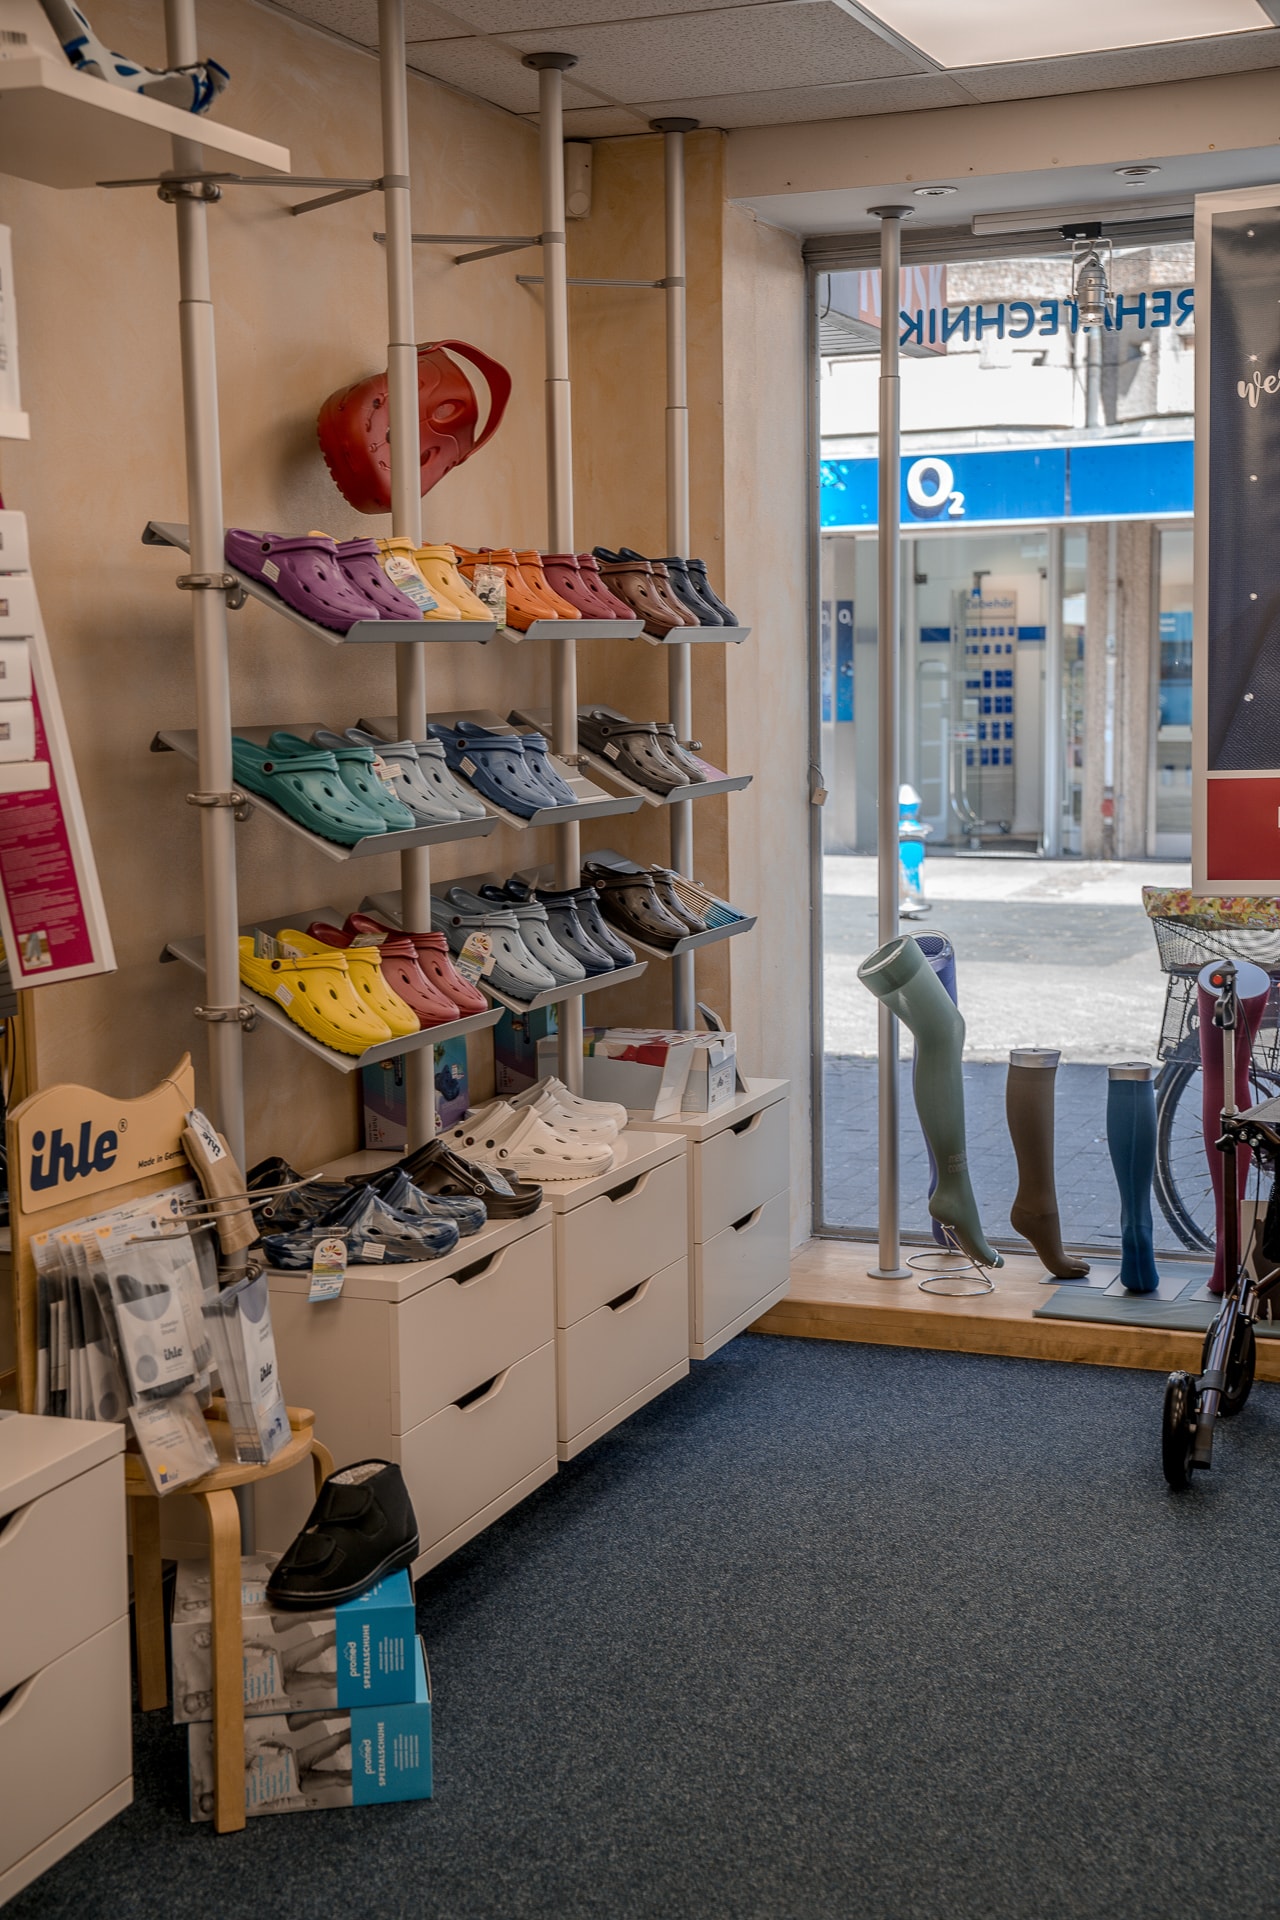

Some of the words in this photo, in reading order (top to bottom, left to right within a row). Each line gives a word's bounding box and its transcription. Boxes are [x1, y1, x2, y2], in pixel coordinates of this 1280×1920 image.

[30, 1121, 118, 1192] ihle
[362, 1624, 371, 1689] SPEZIALSCHUHE
[377, 1722, 386, 1787] SPEZIALSCHUHE
